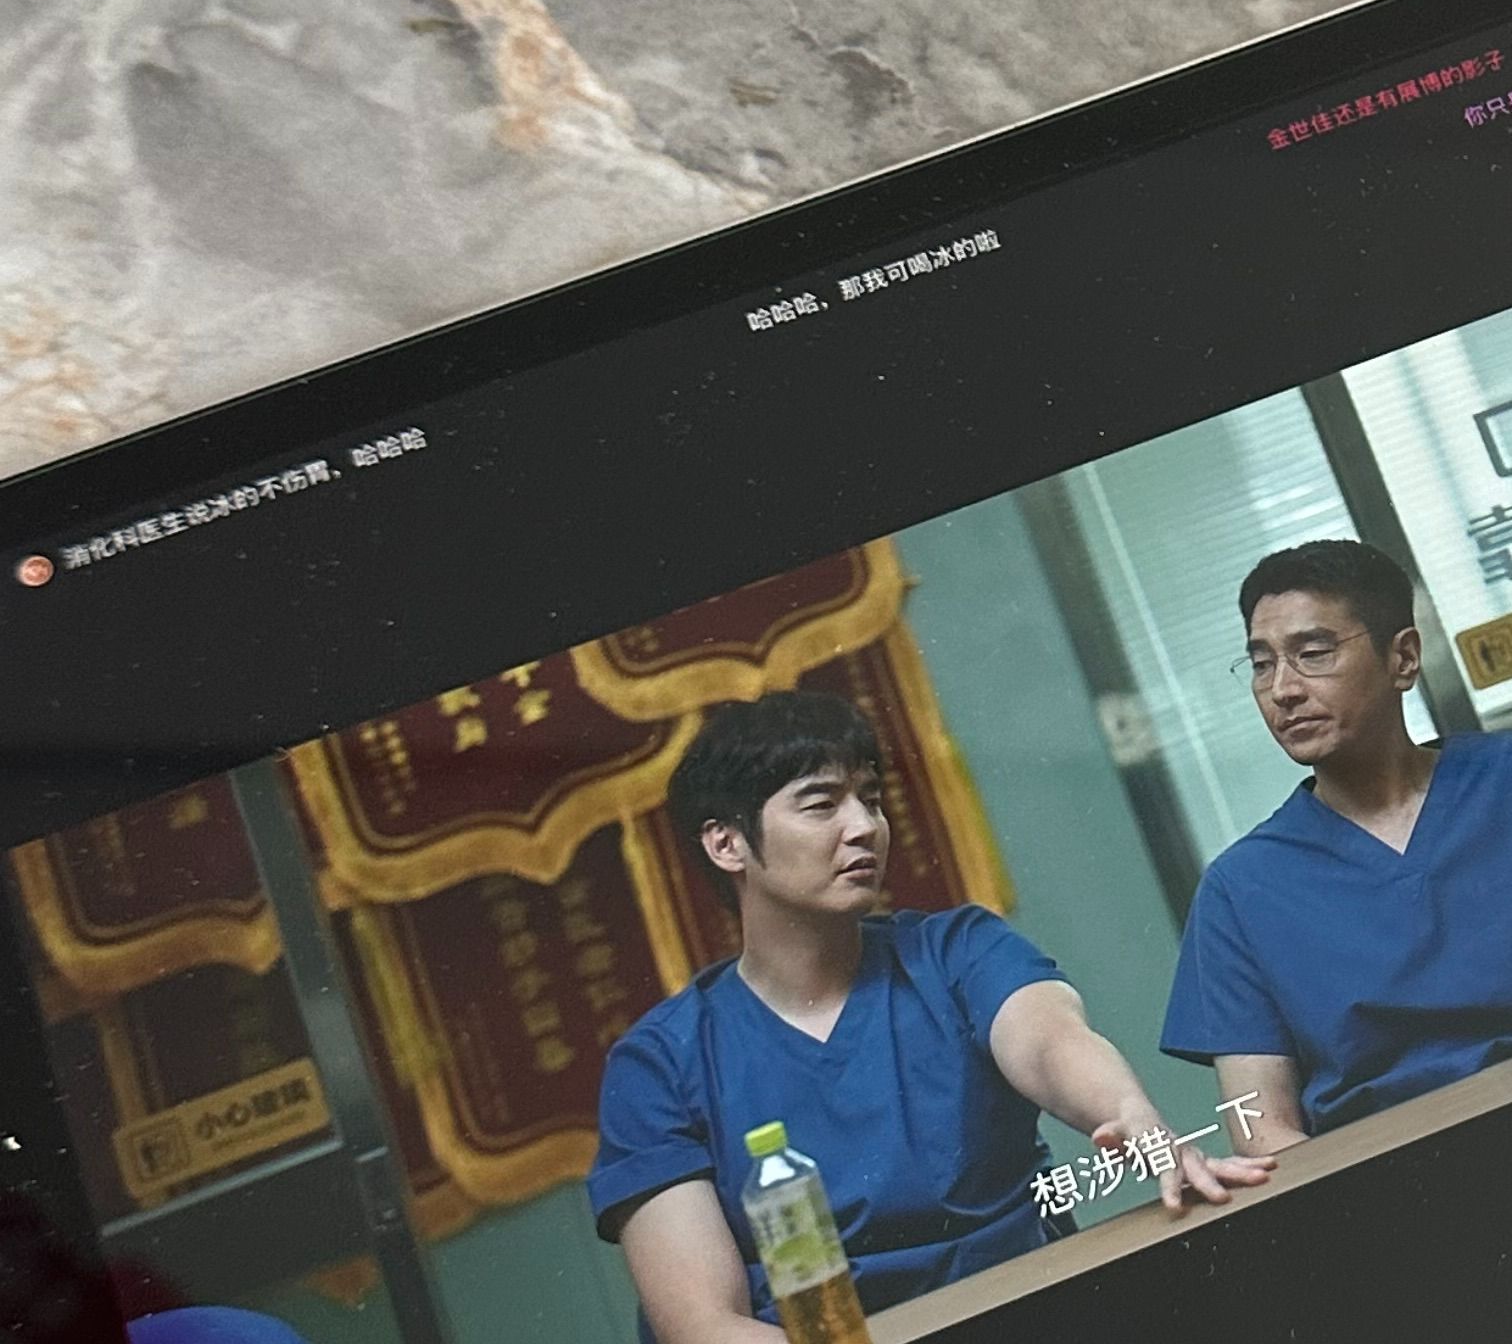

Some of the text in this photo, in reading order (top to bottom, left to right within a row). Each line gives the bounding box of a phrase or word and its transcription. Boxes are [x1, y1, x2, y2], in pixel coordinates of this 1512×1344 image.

[1267, 50, 1504, 150] 金世佳还是有展博的影子
[746, 229, 1001, 332] 哈哈哈，那我可喝冰的啦
[1030, 1090, 1264, 1219] 想涉猎一下
